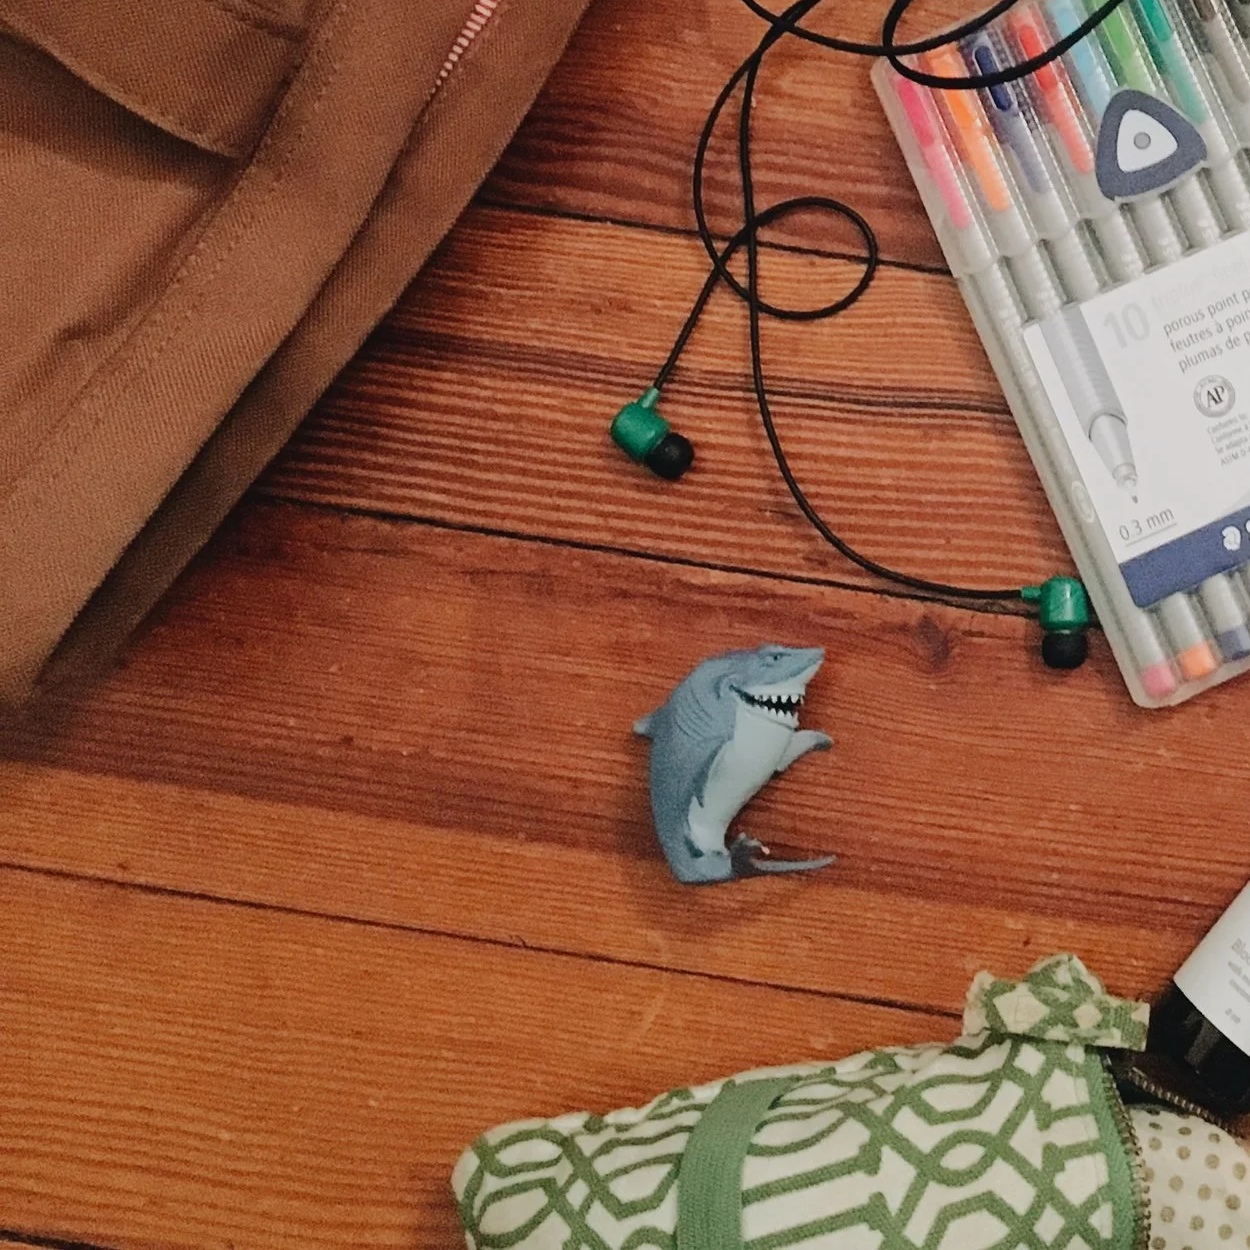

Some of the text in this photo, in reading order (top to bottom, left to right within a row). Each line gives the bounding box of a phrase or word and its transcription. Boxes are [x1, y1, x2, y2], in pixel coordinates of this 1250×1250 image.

[1103, 300, 1150, 350] 10
[1162, 310, 1206, 338] porous
[1206, 292, 1240, 319] point
[1169, 327, 1214, 355] feutres
[1177, 344, 1224, 374] plumas
[1224, 333, 1242, 352] de
[1206, 385, 1225, 408] AP
[1146, 506, 1175, 531] mm
